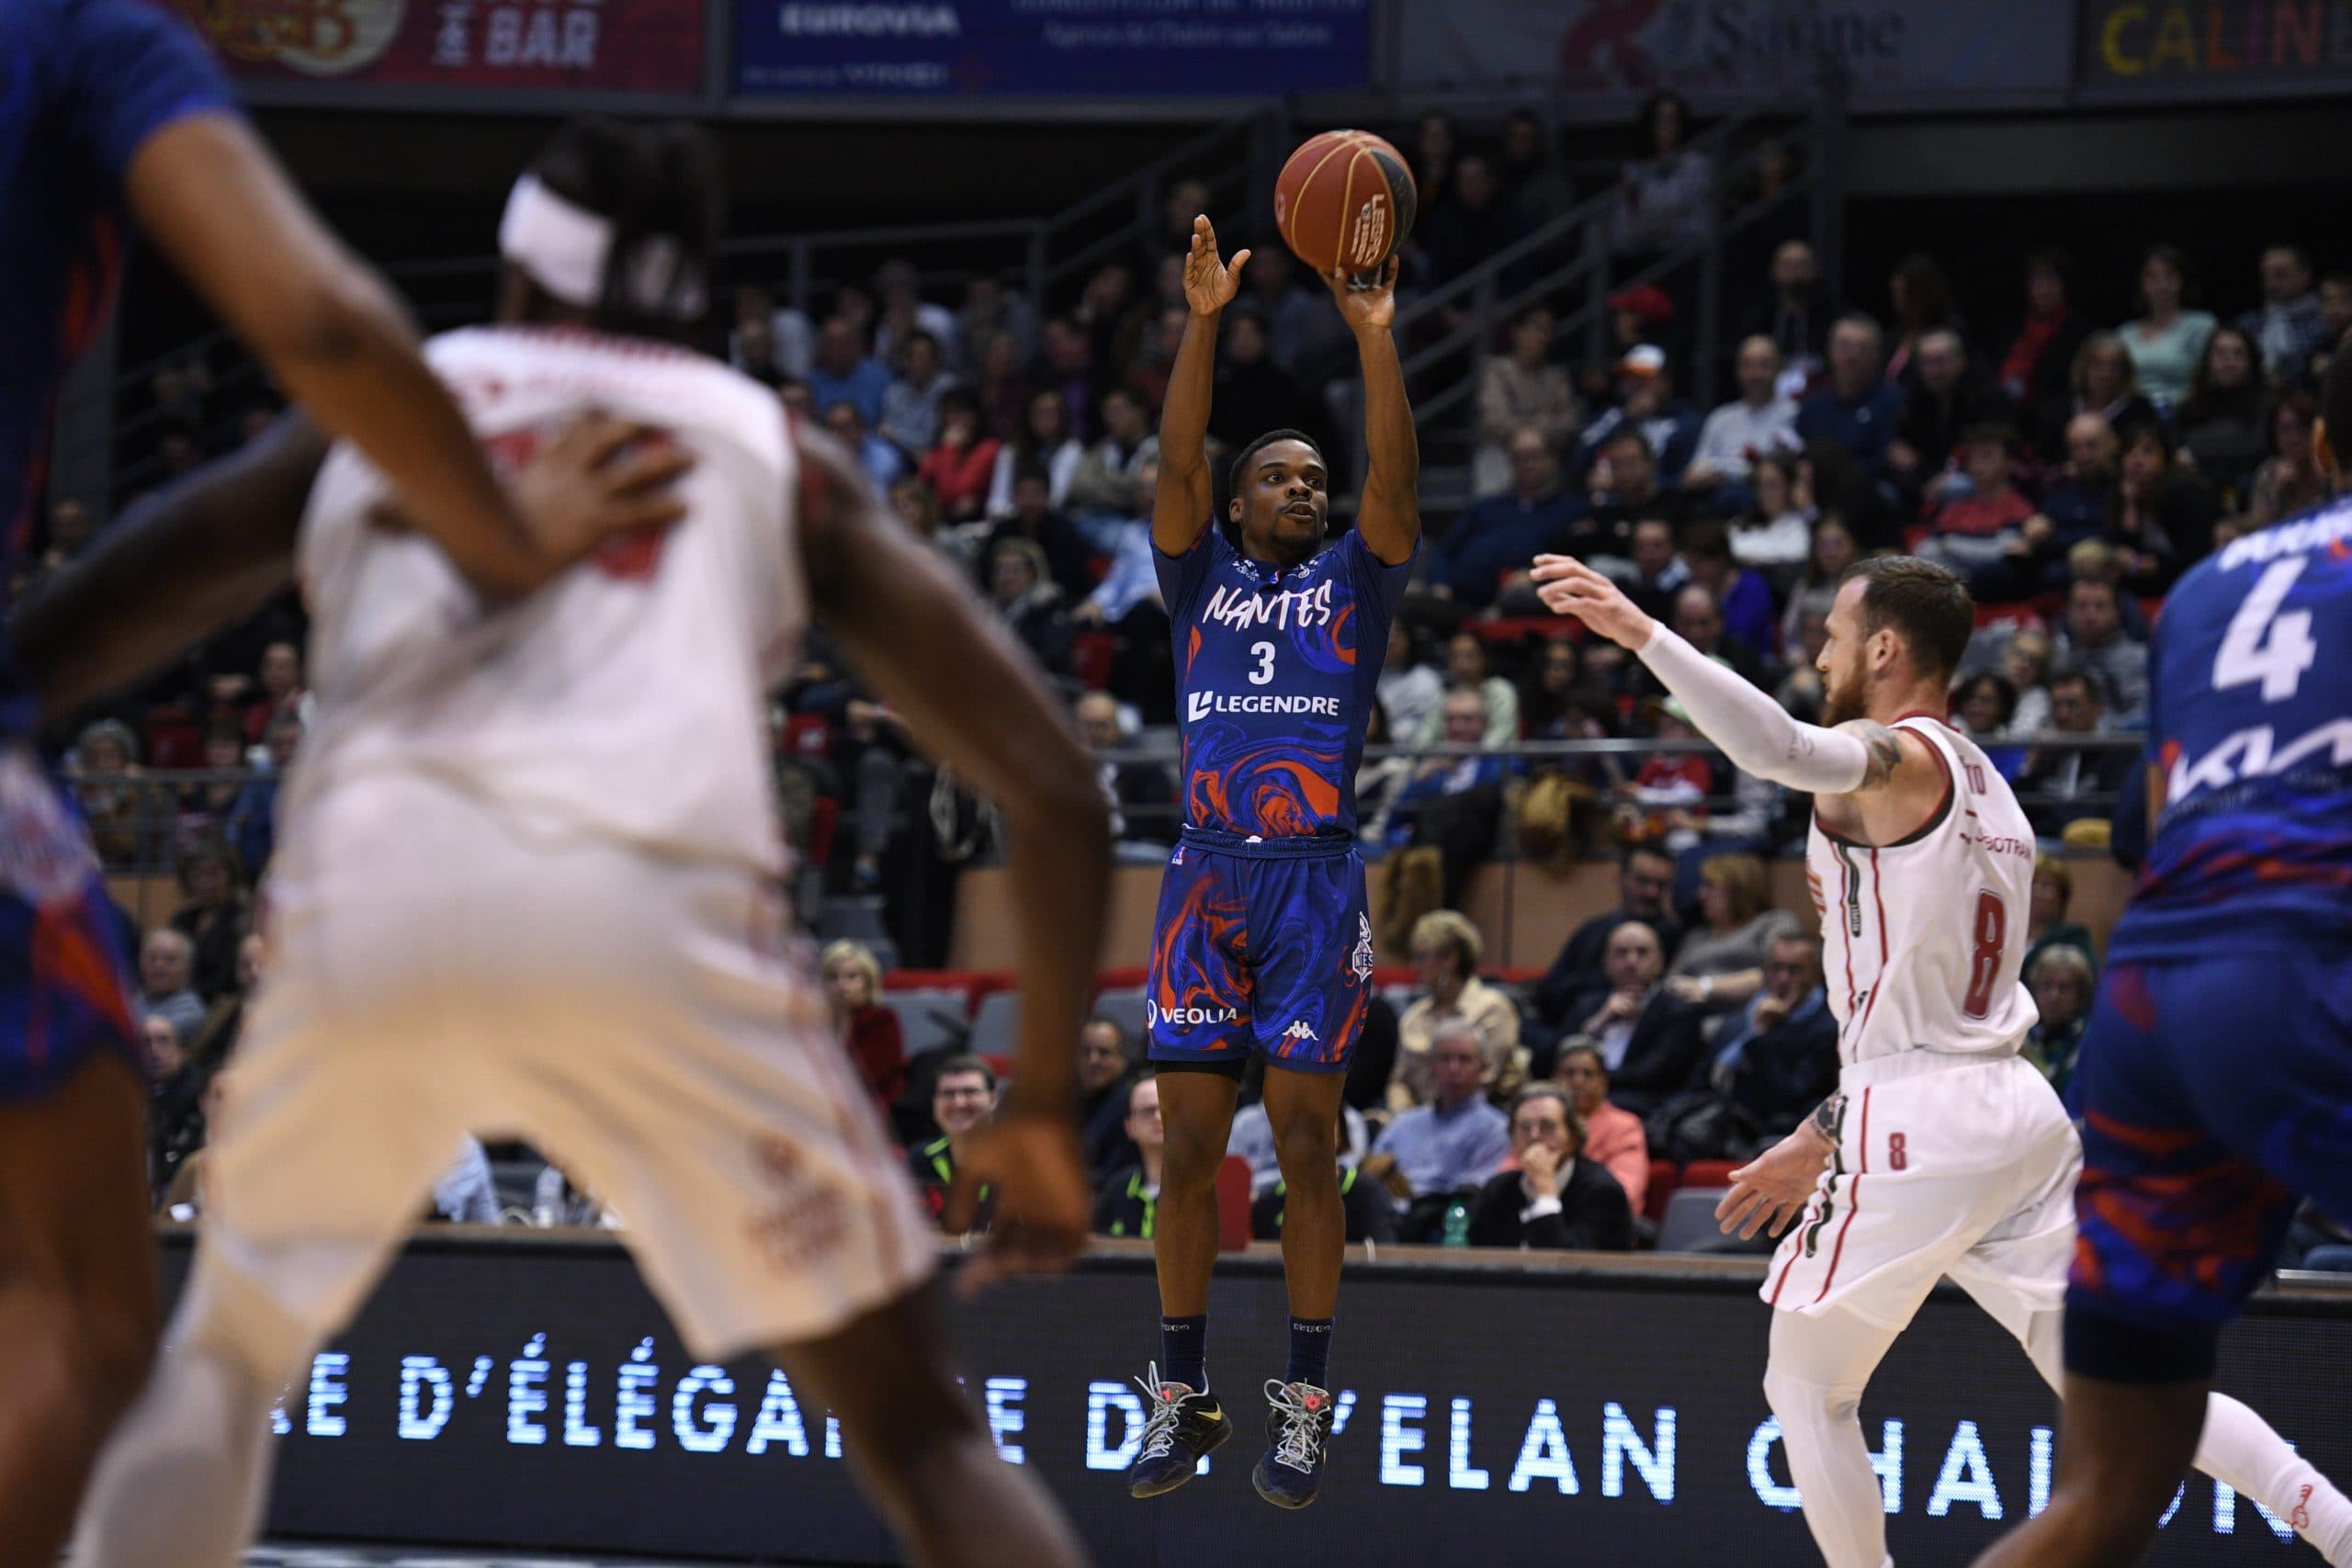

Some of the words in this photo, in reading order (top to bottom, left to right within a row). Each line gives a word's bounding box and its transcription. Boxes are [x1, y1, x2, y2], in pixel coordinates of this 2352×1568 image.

[484, 8, 601, 66] BAR
[1202, 579, 1333, 632] NANTES
[2211, 555, 2317, 705] 4
[1248, 641, 1276, 685] 3
[1215, 695, 1340, 716] LEGENDRE
[1963, 887, 2006, 1021] 8
[1160, 1008, 1238, 1024] VEOLIA
[1888, 1132, 1907, 1171] 8
